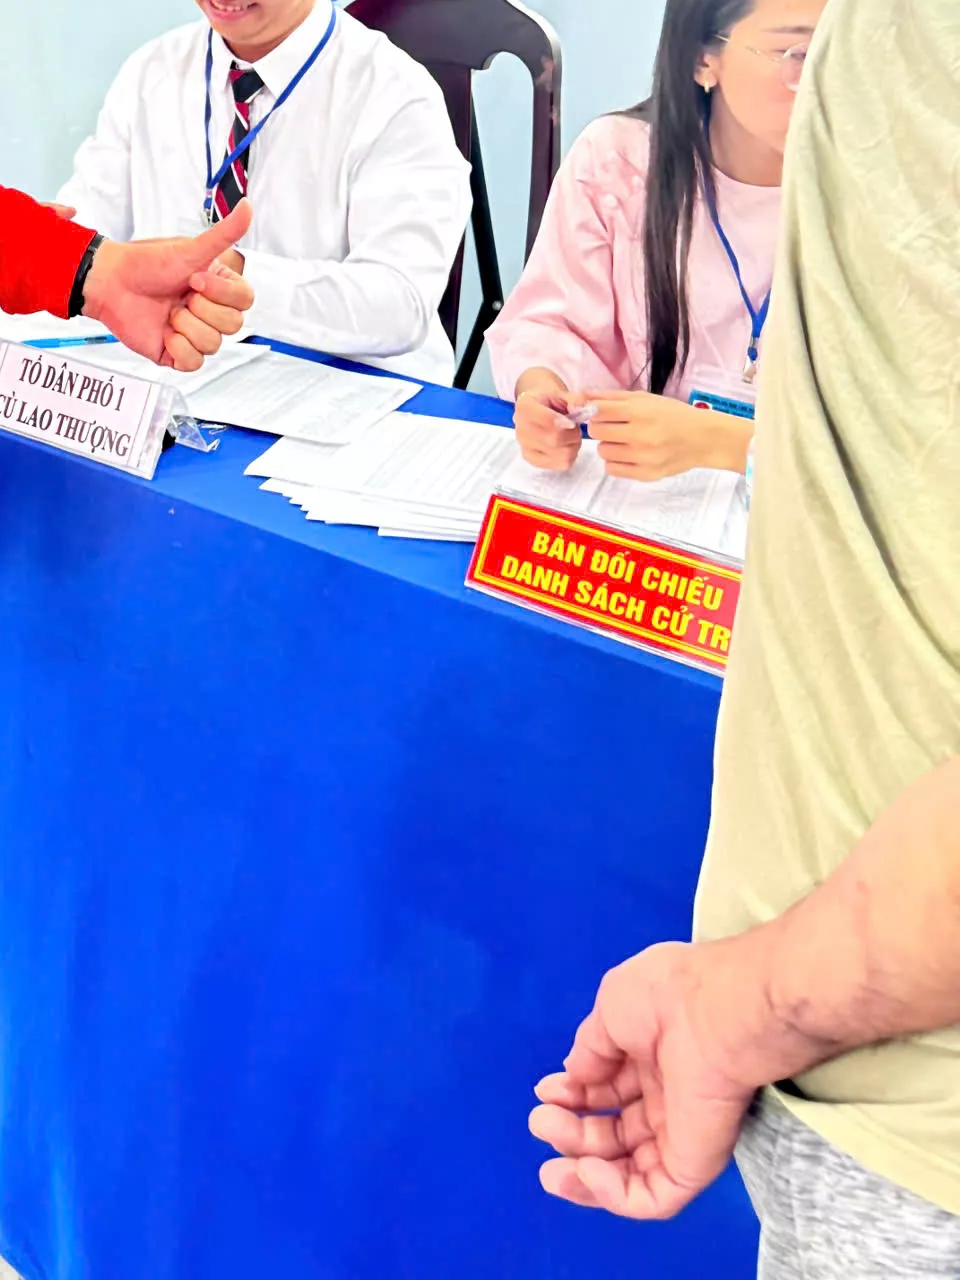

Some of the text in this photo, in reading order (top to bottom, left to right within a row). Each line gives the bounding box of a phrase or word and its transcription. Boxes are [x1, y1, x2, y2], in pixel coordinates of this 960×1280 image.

[41, 361, 80, 397] DÂN
[76, 375, 115, 408] PHỐ
[114, 387, 126, 412] 1
[16, 400, 53, 431] LAO
[55, 412, 131, 457] THƯỢNG
[500, 555, 732, 652] DANH SÁCH CỬ TR
[531, 531, 724, 611] BÀN ĐỐI CHIẾU
